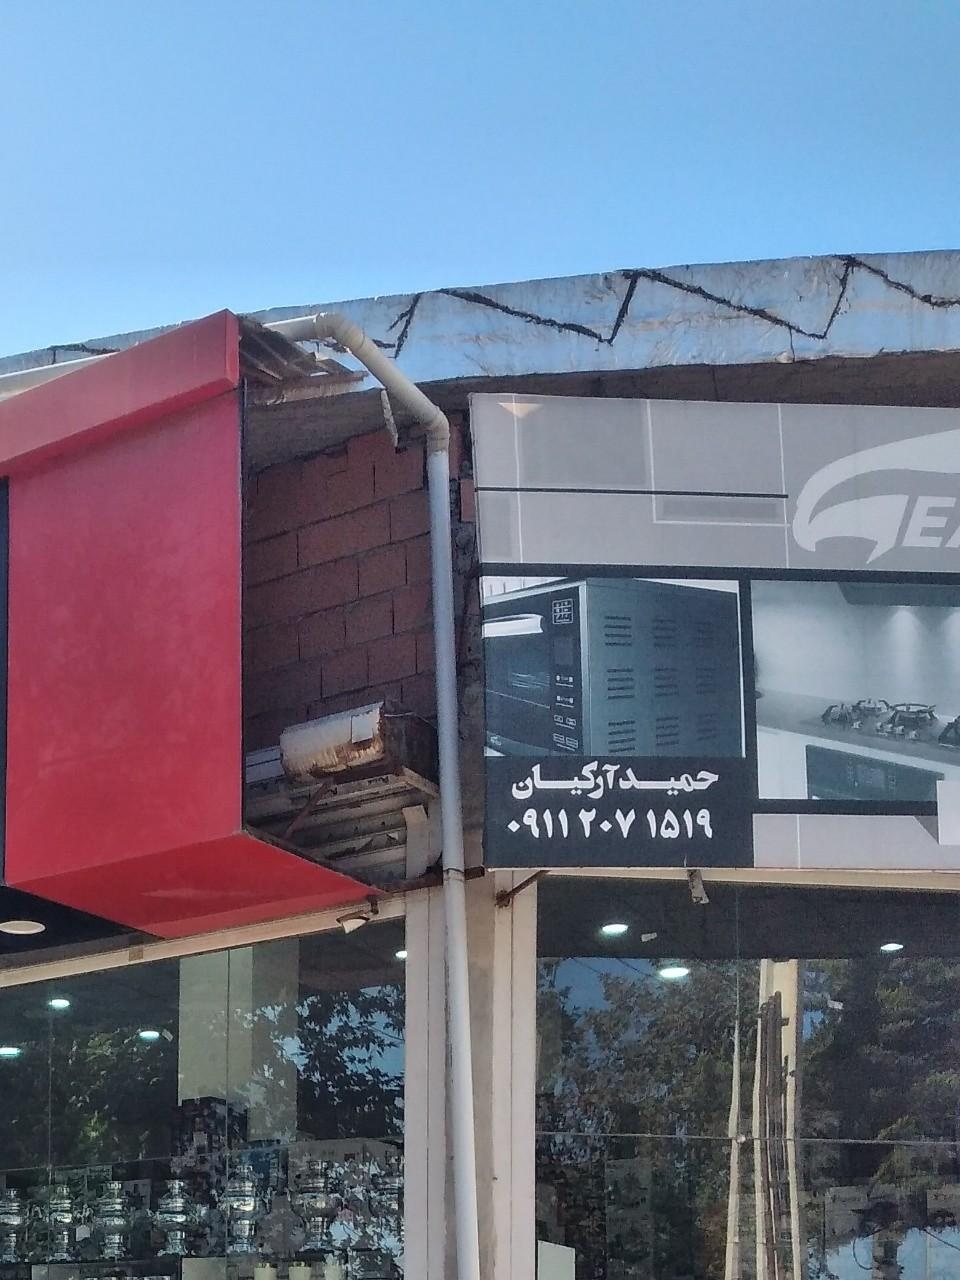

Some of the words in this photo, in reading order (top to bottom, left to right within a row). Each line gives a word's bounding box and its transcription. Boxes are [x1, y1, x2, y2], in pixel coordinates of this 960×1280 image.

[511, 760, 620, 800] آرکیان
[618, 766, 720, 797] حمید
[507, 808, 569, 838] ۰۹۱۱
[578, 808, 636, 838] ۲۰۷
[646, 808, 713, 838] ۱۵۱۹
